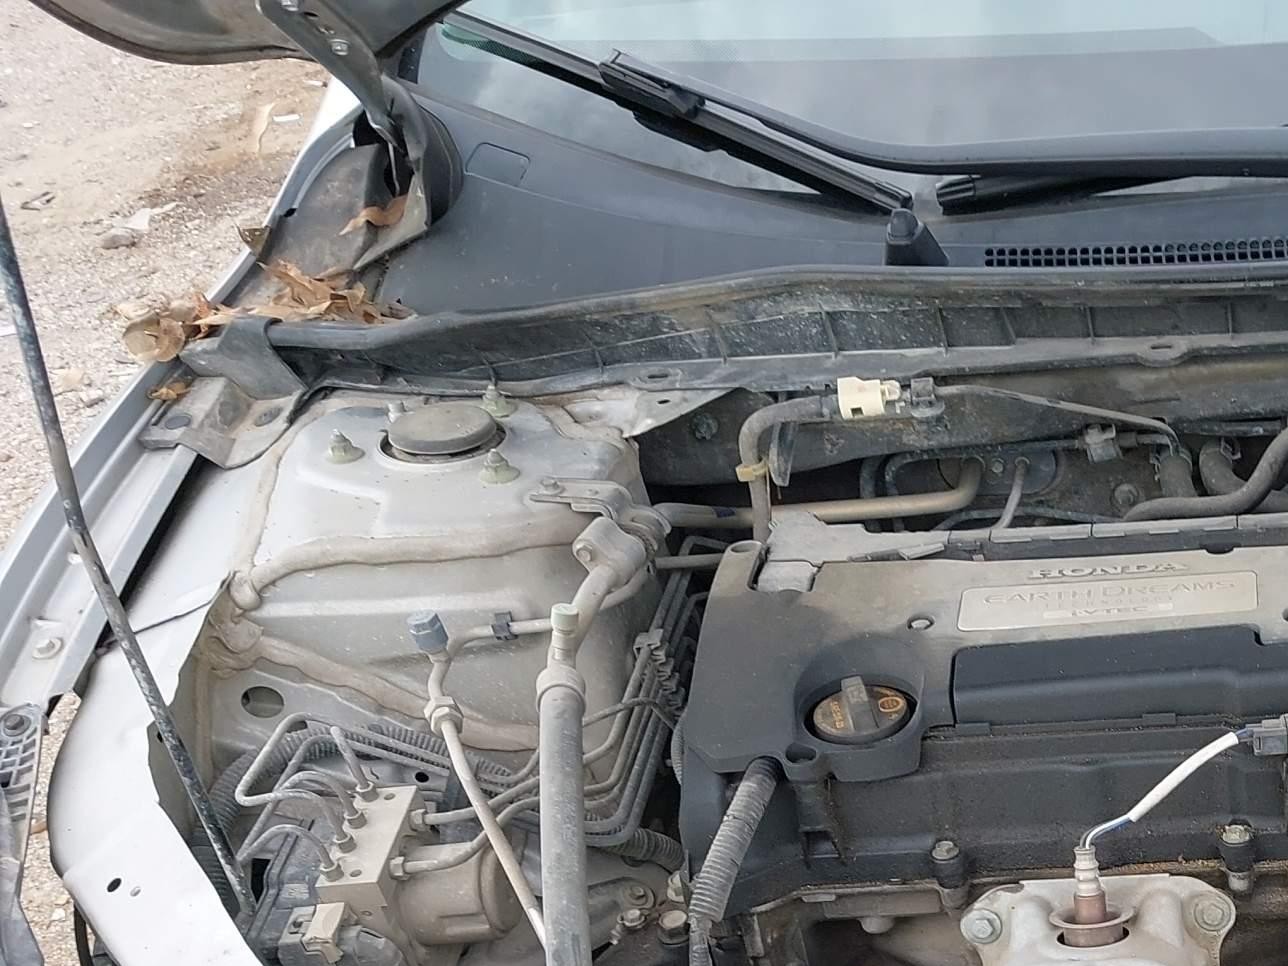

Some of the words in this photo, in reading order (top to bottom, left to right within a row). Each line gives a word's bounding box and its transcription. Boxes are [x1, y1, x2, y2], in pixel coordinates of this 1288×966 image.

[1027, 563, 1188, 580] HONDA
[983, 588, 1091, 604] EARTH
[1102, 581, 1236, 596] DREAMS
